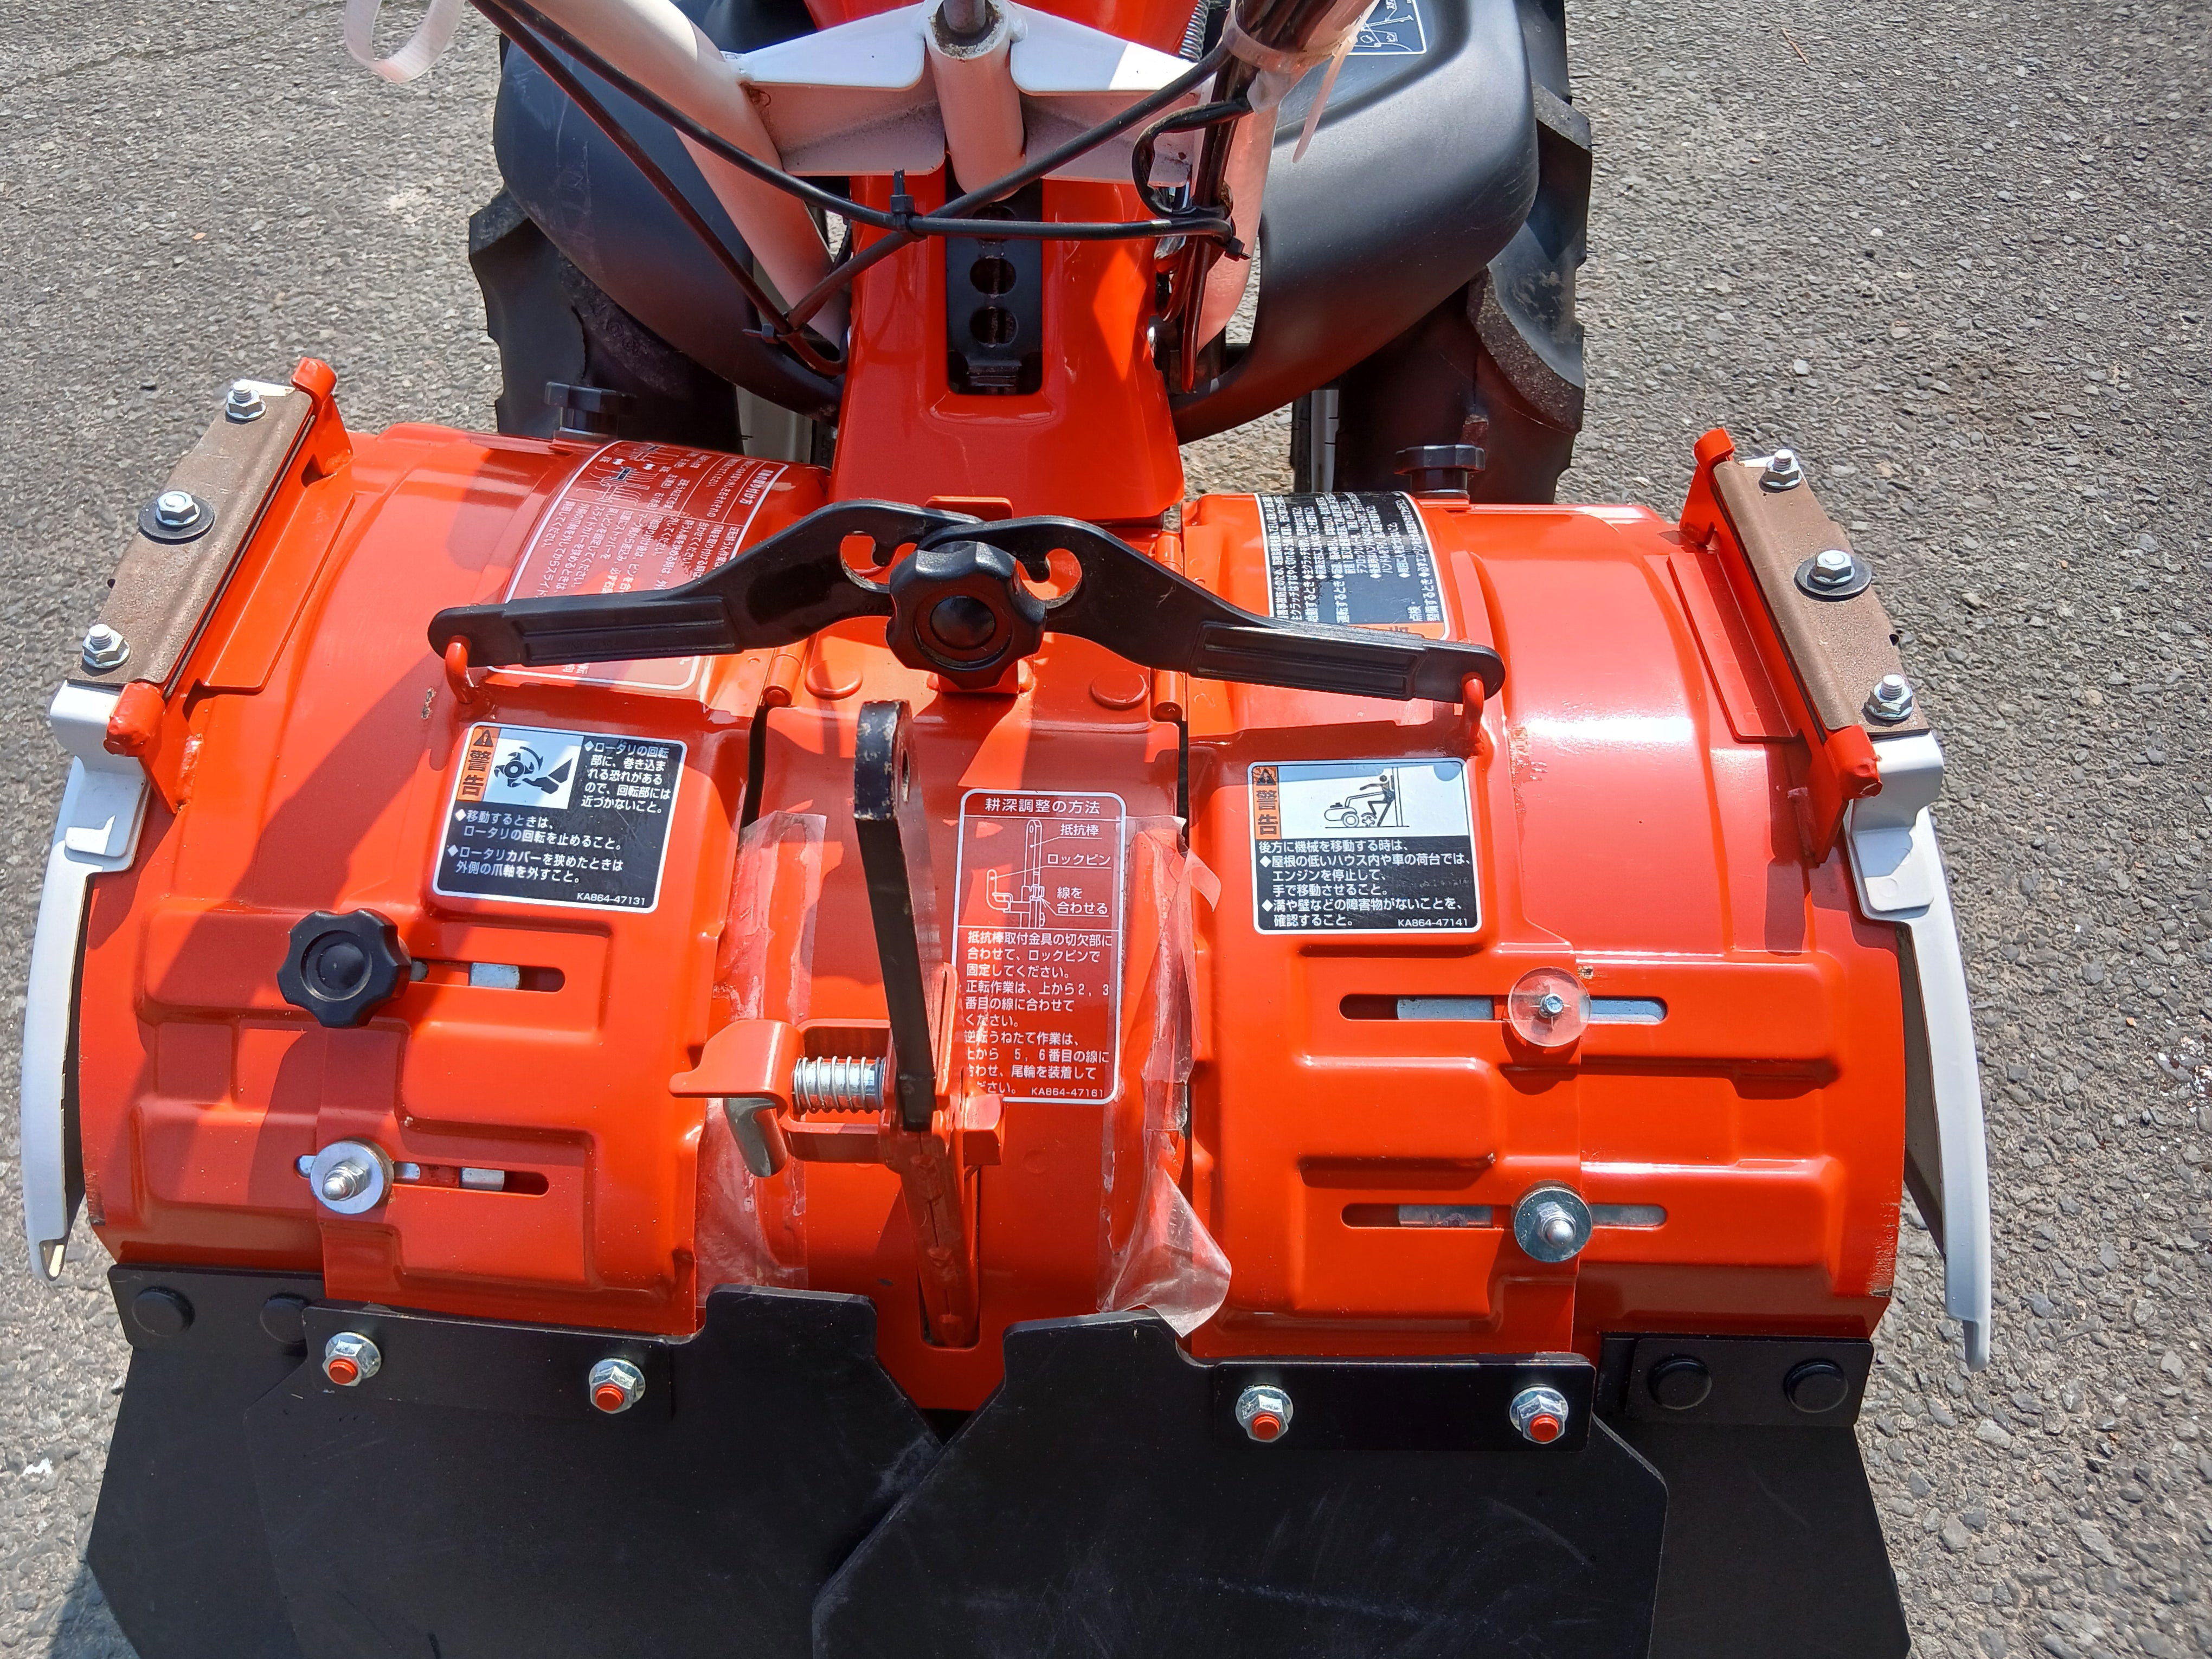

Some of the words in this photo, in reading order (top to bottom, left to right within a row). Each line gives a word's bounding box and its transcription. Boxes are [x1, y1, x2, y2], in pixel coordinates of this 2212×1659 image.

[1332, 580, 1349, 622] 運転するとき
[1420, 578, 1440, 621] 整備するとき
[595, 741, 669, 758] ロータリの回転
[591, 755, 665, 771] 部に、巻き込ま
[462, 749, 490, 795] 警告
[588, 768, 662, 783] れる恐れがある
[585, 782, 670, 800] ので、回転部には
[581, 795, 662, 813] 近づかないこと。
[985, 798, 1101, 814] 耕深調整の方法
[1256, 789, 1278, 834] 警告
[467, 810, 554, 829] 移動するときは、
[1060, 824, 1099, 836] 抵抗棒
[464, 826, 621, 850] ロータリの回転を止めること。
[1258, 840, 1408, 853] 後方に機械を移動する時は、
[460, 847, 623, 871] ロータリカバーを狭めたときは
[1047, 854, 1111, 865] ロックピン
[1272, 853, 1470, 867] 屋根の低いハウス内や車の荷台では、
[456, 861, 579, 884] 外側の爪軸を外すこと。
[1272, 869, 1386, 882] エンジンを停止して、
[1057, 887, 1082, 899] 線を
[1272, 884, 1387, 897] 手で移動させること。
[577, 893, 645, 906] KA864-47131
[1274, 897, 1462, 911] 溝や壁などの障害物がないことを、
[1057, 903, 1108, 915] 合わせる
[1274, 914, 1352, 928] 確認すること。
[1398, 918, 1468, 928] KA864-47141
[968, 931, 1113, 947] 抵抗棒取付金具の切欠部に
[967, 948, 1100, 962] 合わせて、ロックピンで
[966, 964, 1069, 978] 固定してください。
[965, 998, 1075, 1012] 番目の線に合わせて
[966, 1014, 1019, 1027] ください。
[964, 1031, 1078, 1046] 逆転うねたて作業は、
[1031, 1087, 1103, 1097] KA864-47161
